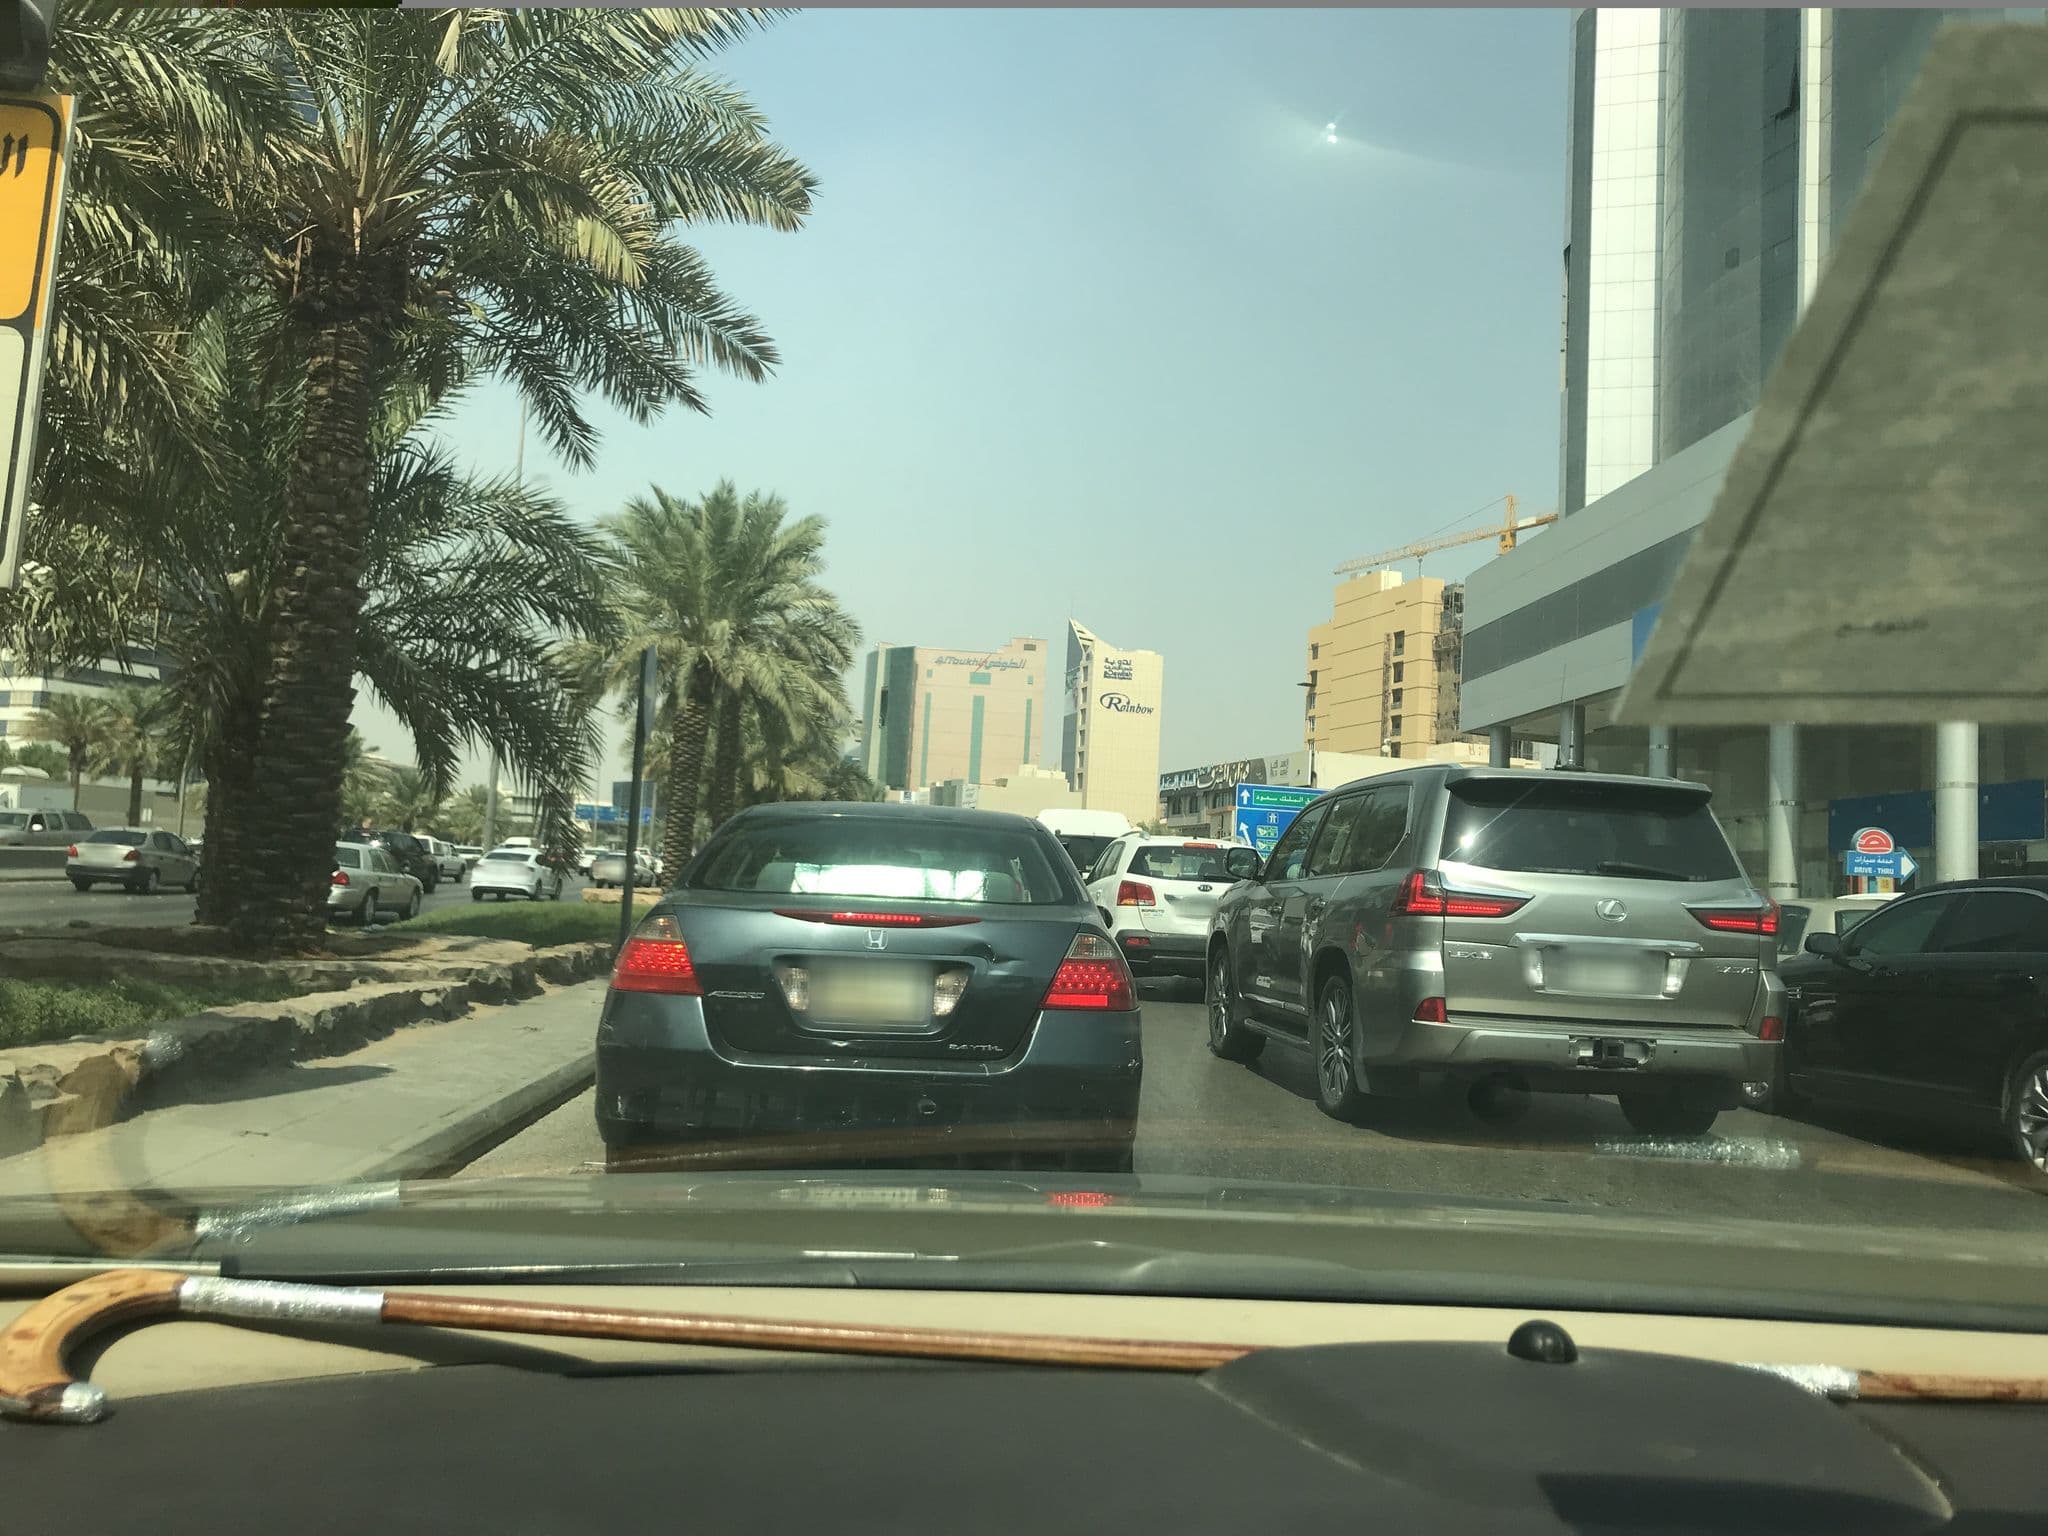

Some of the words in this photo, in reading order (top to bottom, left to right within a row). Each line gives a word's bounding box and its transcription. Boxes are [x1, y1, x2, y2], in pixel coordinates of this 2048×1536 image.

[1100, 692, 1154, 714] Rainbow
[1255, 794, 1278, 802] سعود
[1279, 795, 1304, 803] الملك
[1854, 856, 1875, 865] سيارات
[1876, 856, 1894, 864] خدمة
[1854, 866, 1872, 874] DRIVE
[1878, 867, 1894, 875] THRU
